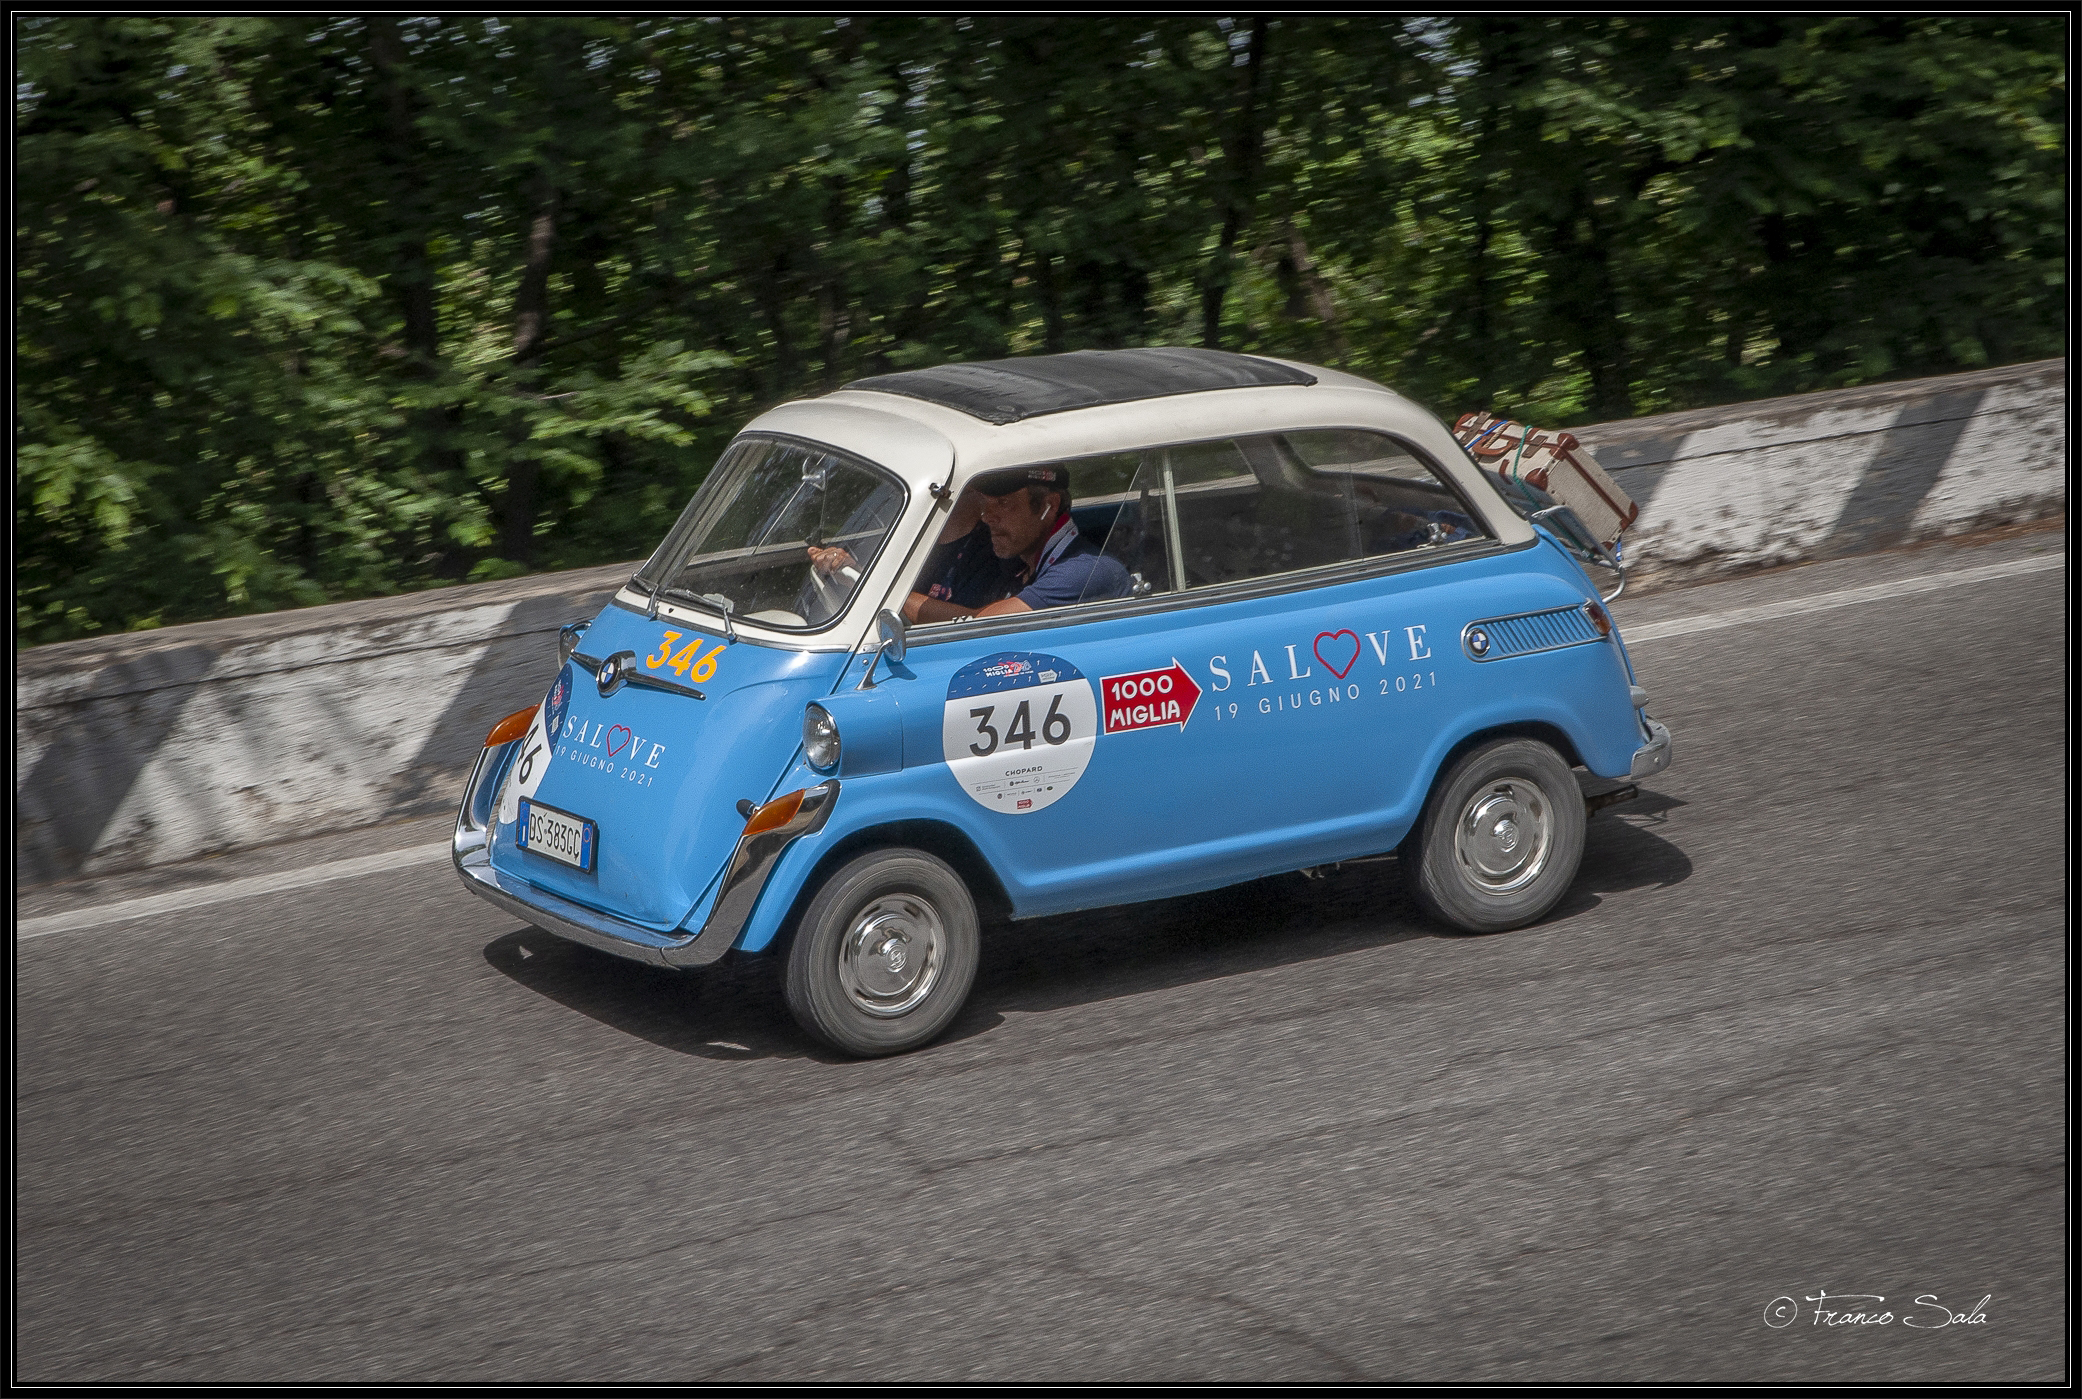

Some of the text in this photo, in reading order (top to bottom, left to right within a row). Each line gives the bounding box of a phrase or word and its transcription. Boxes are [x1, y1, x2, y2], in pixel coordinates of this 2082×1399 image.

[645, 630, 727, 683] 346
[1111, 675, 1173, 701] 1000
[1215, 671, 1436, 721] 19 GIUGNO 2021
[969, 693, 1071, 757] 346
[1110, 700, 1180, 728] MIGLIA
[518, 723, 542, 785] 46
[570, 750, 614, 773] GIUGNO
[620, 767, 653, 787] 2021
[1005, 765, 1043, 776] CHOPARD
